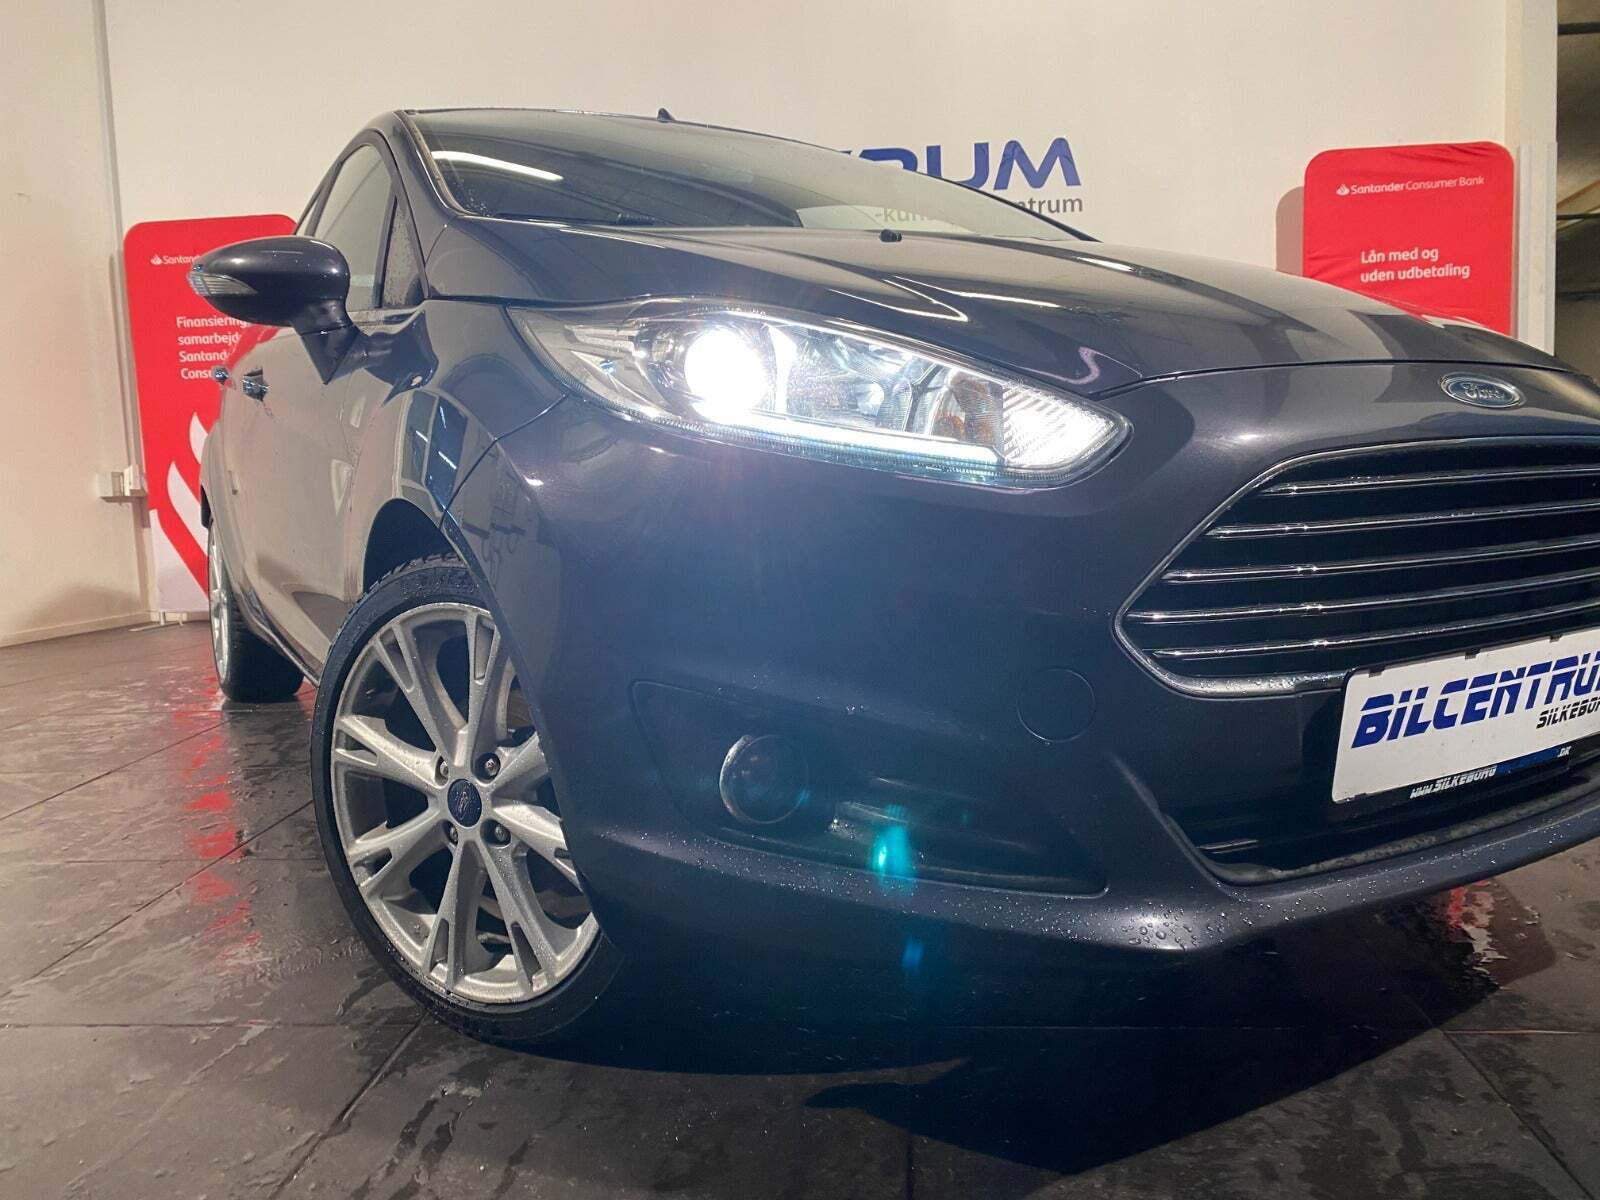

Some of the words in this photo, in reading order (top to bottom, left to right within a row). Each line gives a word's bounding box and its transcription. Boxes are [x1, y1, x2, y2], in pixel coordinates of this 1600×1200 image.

[1459, 176, 1484, 187] Bank
[1361, 249, 1385, 264] Lån
[1388, 247, 1418, 261] med
[1421, 248, 1439, 262] og
[1361, 269, 1395, 282] uden
[1397, 263, 1470, 280] udbetaling
[178, 332, 241, 346] samarbejd
[179, 350, 229, 362] Santand
[1351, 651, 1600, 749] BILCENTRU
